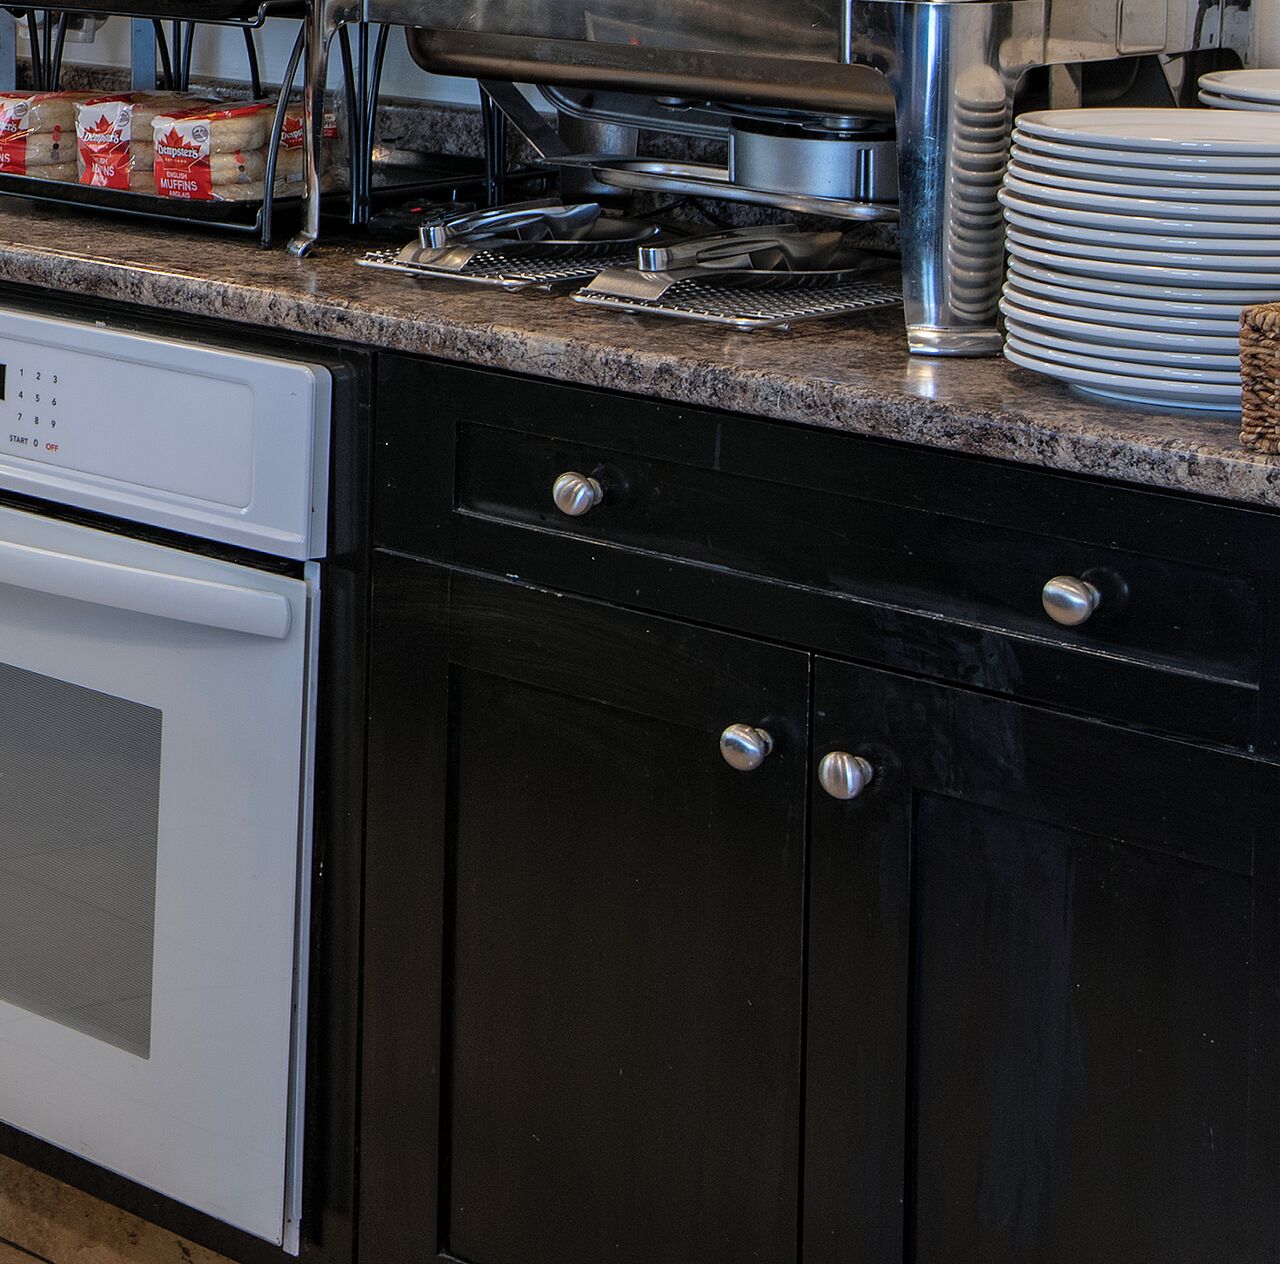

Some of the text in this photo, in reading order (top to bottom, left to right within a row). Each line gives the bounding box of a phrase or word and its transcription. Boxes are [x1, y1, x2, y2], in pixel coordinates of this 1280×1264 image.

[158, 144, 200, 159] Dempster's
[166, 170, 188, 180] ENGLISH
[160, 178, 198, 192] MUFFINS
[36, 372, 41, 381] 2
[53, 375, 58, 384] 3
[19, 391, 57, 406] 4 5 6
[18, 412, 56, 428] 7 8 9
[9, 434, 59, 452] START 0 OFF
